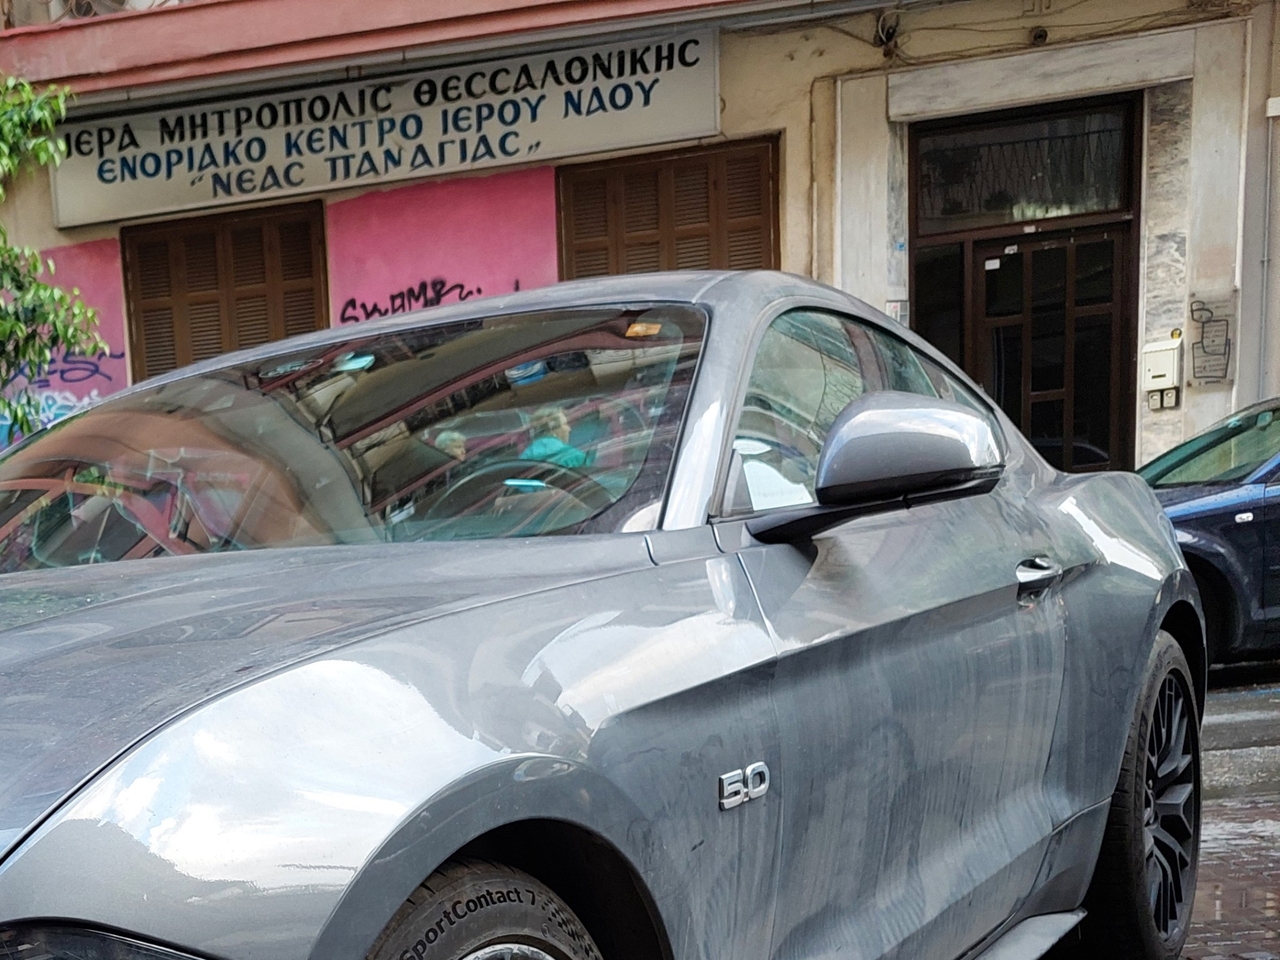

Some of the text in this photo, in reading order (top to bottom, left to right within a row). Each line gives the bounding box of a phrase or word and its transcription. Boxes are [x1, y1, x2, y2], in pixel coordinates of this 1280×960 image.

[64, 122, 140, 160] ΙΕΡΑ
[97, 77, 660, 184] ΕΝΟΡΙΑΚΟ ΚΕΝΤΡΟ ΙΕΡΟΥ ΝΑΟΥ
[718, 761, 770, 812] 5.0
[525, 889, 537, 906] 7
